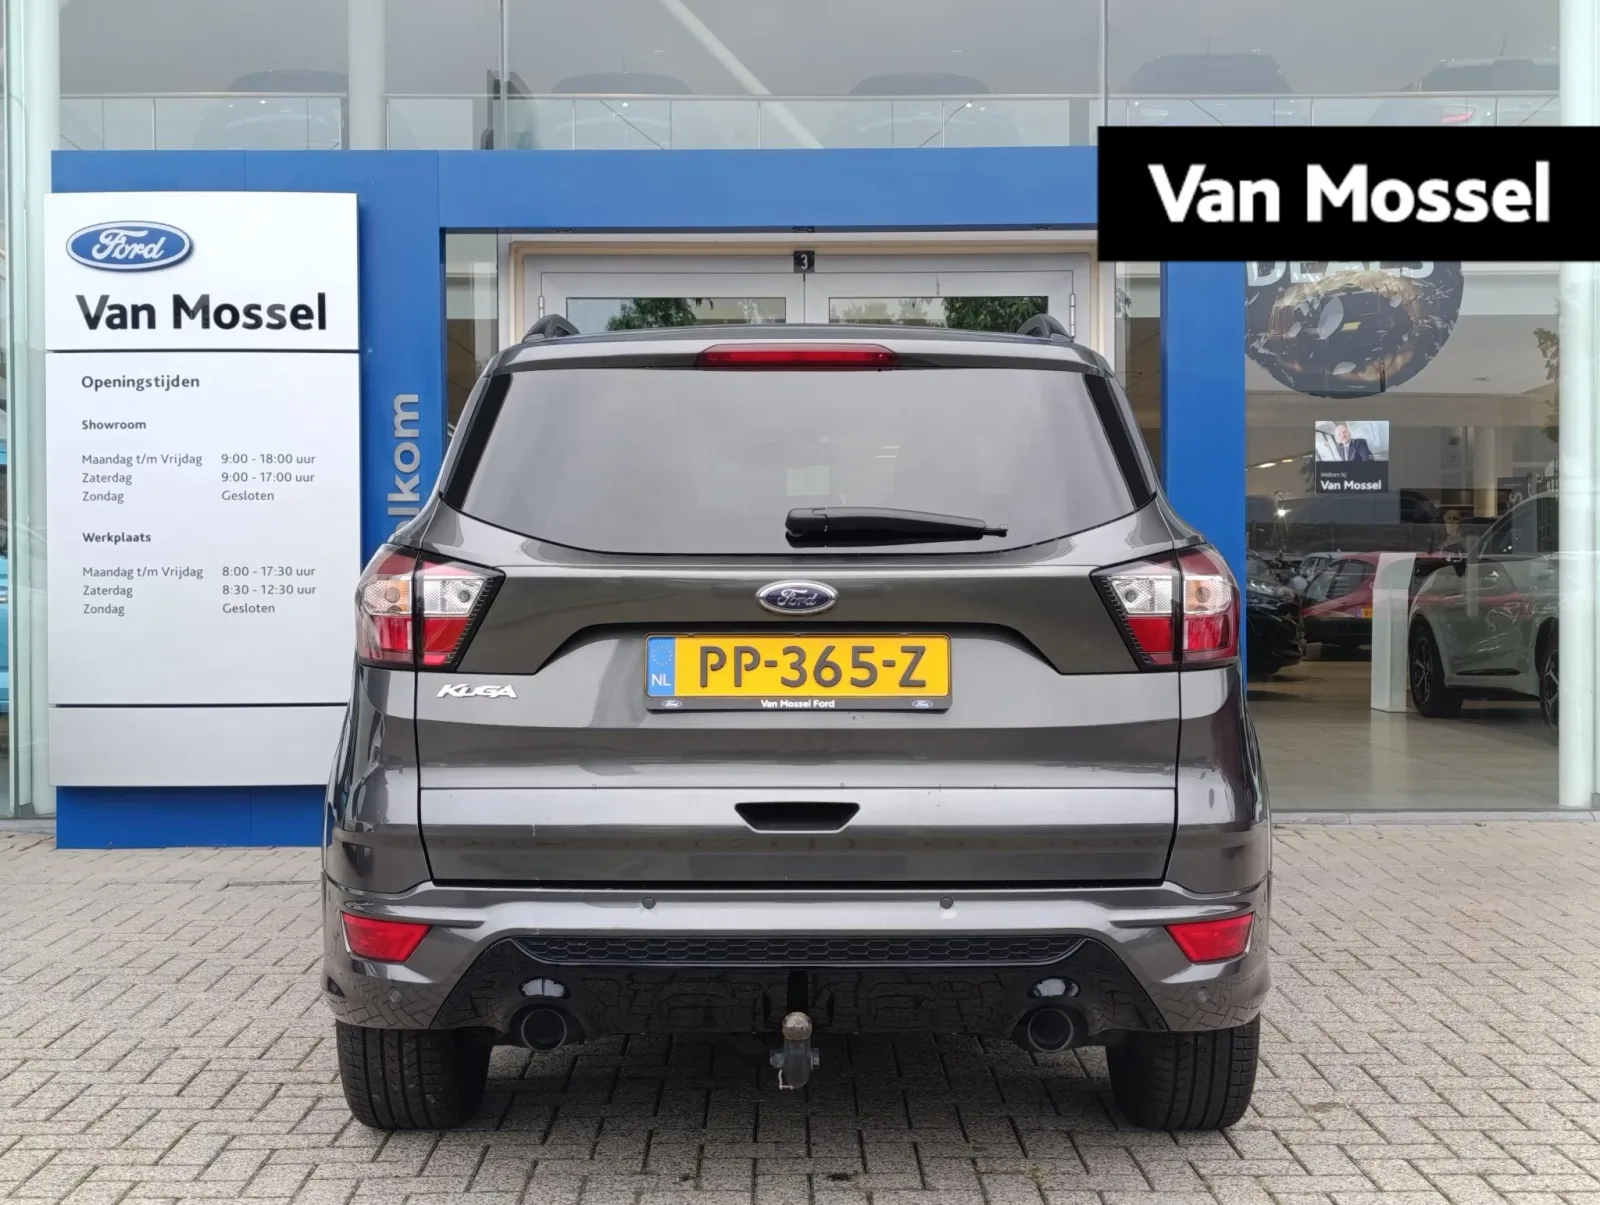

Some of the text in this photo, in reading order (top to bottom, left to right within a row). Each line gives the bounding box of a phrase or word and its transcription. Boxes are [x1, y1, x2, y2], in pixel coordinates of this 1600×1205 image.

[91, 228, 167, 260] Ford
[800, 254, 808, 269] 3
[75, 292, 327, 330] Van Mossel
[81, 374, 200, 392] Openingstijden
[81, 419, 147, 430] Showroom
[81, 453, 134, 467] Maandag
[135, 453, 158, 465] t/m
[160, 453, 203, 467] Vrijdag
[221, 453, 248, 464] 9:00
[260, 453, 293, 464] 18:00
[296, 455, 316, 464] uur
[81, 472, 133, 485] Zaterdag
[221, 471, 249, 482] 9:00
[260, 471, 292, 482] 17:00
[296, 474, 315, 482] uur
[1320, 480, 1382, 490] Van Mossel
[82, 489, 275, 504] Zondag Gesloten
[82, 532, 152, 546] Werkplaats
[82, 566, 134, 580] Maandag
[136, 566, 158, 577] t/m
[161, 566, 204, 580] Vrijdag
[222, 566, 250, 577] 8:00
[260, 566, 293, 577] 17:30
[296, 568, 316, 577] uur
[83, 584, 133, 598] Zaterdag
[222, 584, 250, 595] 8:30
[260, 584, 294, 595] 12:30
[297, 586, 317, 595] uur
[776, 588, 818, 606] Ford
[83, 602, 275, 617] Zondag Gesloten
[699, 645, 927, 688] PP-365-Z
[651, 673, 672, 687] NL
[436, 683, 518, 698] KUGA
[760, 699, 835, 708] Van Mossel Ford
